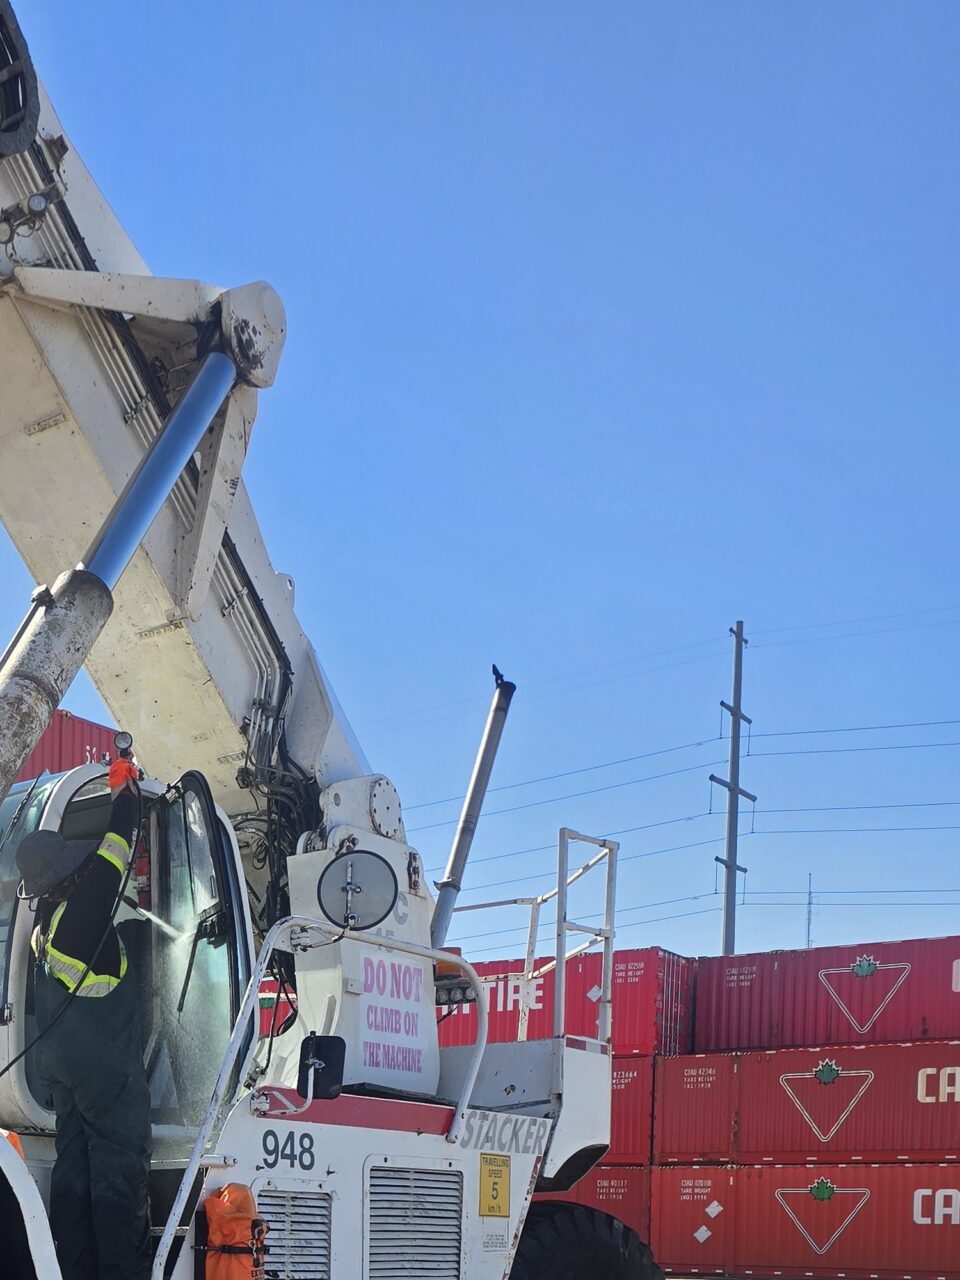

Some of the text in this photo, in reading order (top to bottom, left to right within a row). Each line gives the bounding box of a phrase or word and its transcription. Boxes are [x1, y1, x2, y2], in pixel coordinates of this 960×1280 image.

[363, 957, 422, 1002] DO NOT
[367, 1004, 401, 1034] CLIMB
[404, 1010, 418, 1037] ON
[363, 1041, 422, 1073] THE MACHINE
[460, 1111, 548, 1155] STACKER
[262, 1129, 315, 1171] 948
[482, 1156, 509, 1168] TRAVELLING
[488, 1169, 503, 1179] SPEED
[491, 1182, 499, 1200] 5
[488, 1204, 502, 1213] km/h
